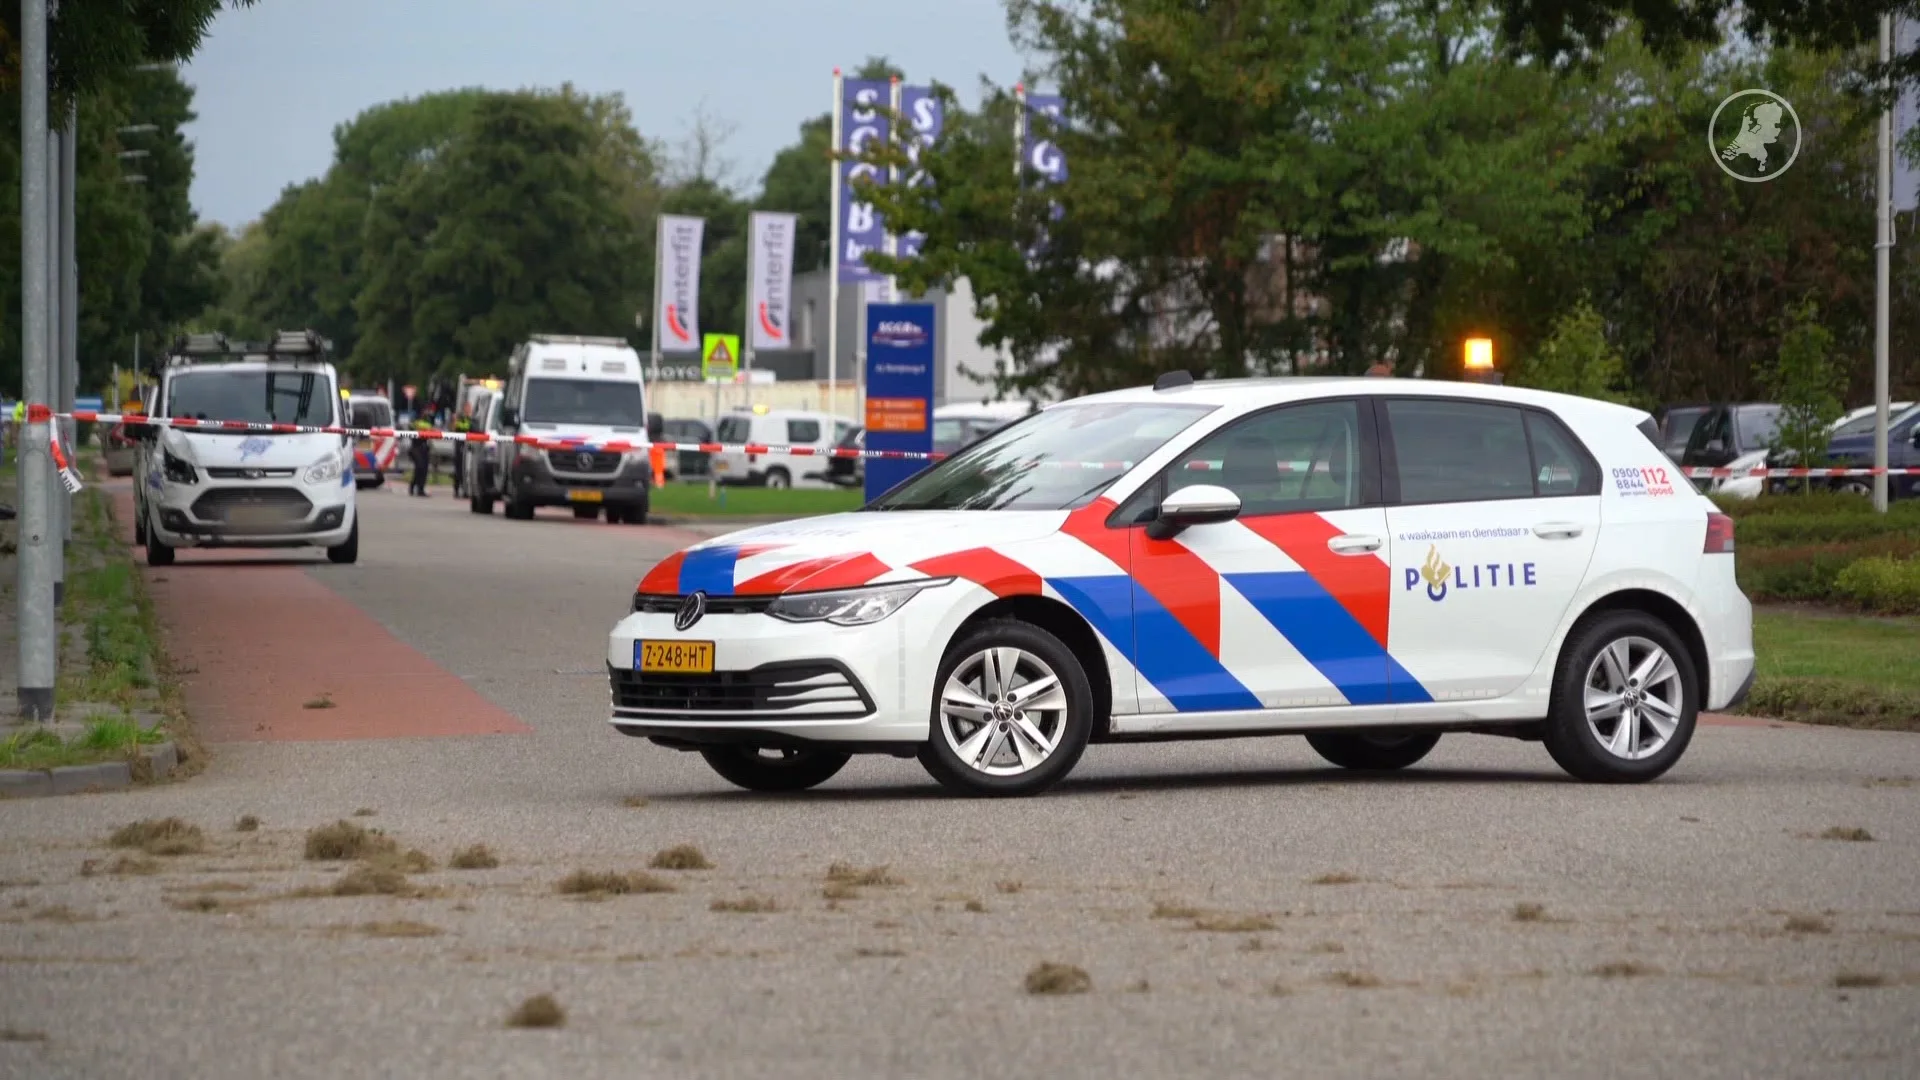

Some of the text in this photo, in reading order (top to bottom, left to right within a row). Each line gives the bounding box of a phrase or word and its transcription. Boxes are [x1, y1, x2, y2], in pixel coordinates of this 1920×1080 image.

[671, 226, 692, 314] interfit
[763, 223, 785, 313] interfit
[1612, 467, 1670, 485] 0900 112
[1616, 479, 1643, 489] 8844
[1647, 485, 1674, 497] spoed
[1407, 530, 1458, 541] waakzaam
[1459, 531, 1471, 539] en
[1473, 527, 1522, 539] dienstbaar
[1405, 563, 1537, 602] POLITIE
[645, 645, 707, 668] Z-248-HT
